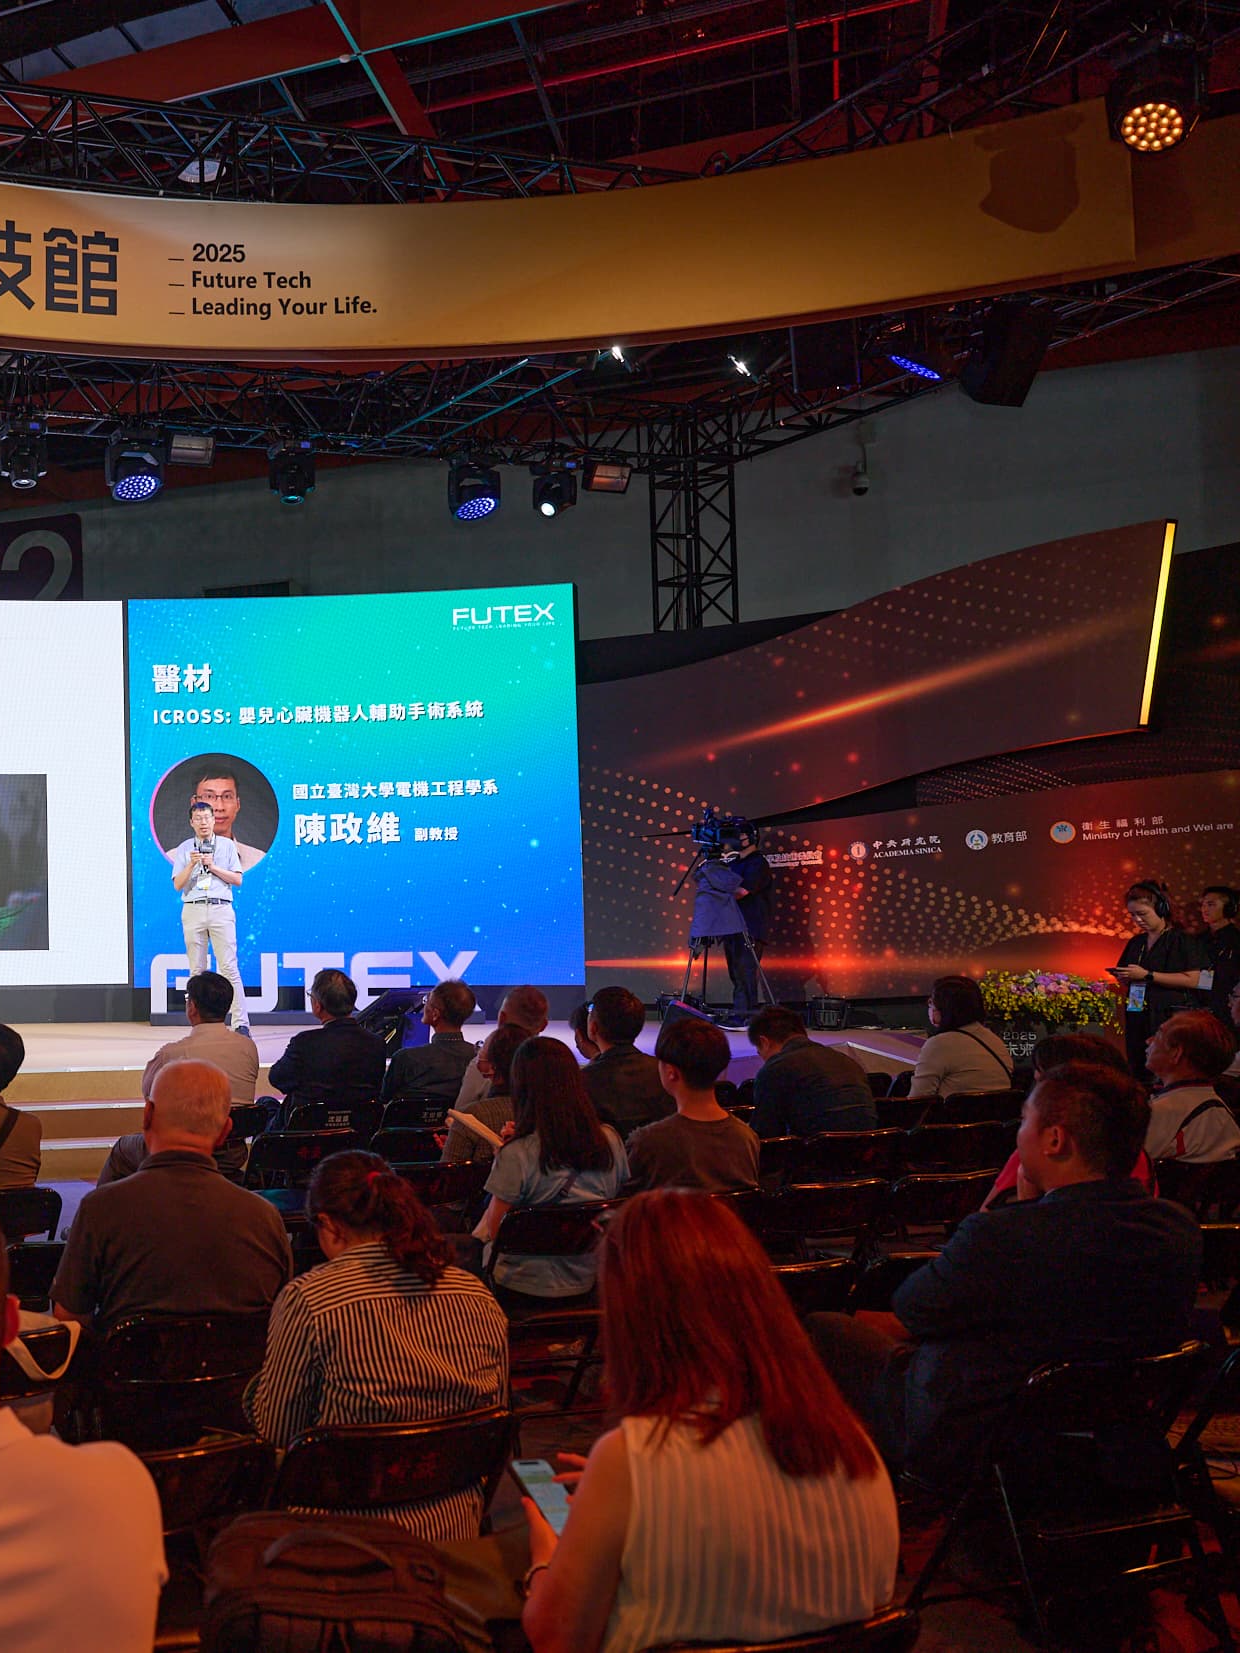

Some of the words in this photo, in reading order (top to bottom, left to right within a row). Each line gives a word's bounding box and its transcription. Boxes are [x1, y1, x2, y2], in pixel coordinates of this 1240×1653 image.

[192, 243, 246, 263] 2025
[192, 270, 258, 289] Future
[263, 270, 312, 289] Tech
[192, 298, 272, 320] Leading
[278, 298, 328, 315] Your
[334, 296, 377, 315] Life.
[452, 602, 555, 626] FUTEX
[151, 663, 212, 694] 醫材
[152, 708, 231, 725] ICROSS:
[238, 700, 484, 726] 嬰兒心臟機器人輔助手術系統
[292, 778, 499, 801] 國立臺灣大學電機工程學系
[294, 811, 402, 846] 陳政維
[414, 826, 459, 842] 副教授
[991, 830, 1028, 844] 教育部
[1082, 829, 1121, 841] Ministry
[1123, 829, 1133, 838] of
[1135, 826, 1169, 837] Health
[1171, 825, 1190, 834] and
[873, 849, 914, 859] ACADEMIA
[914, 846, 942, 855] SINICA
